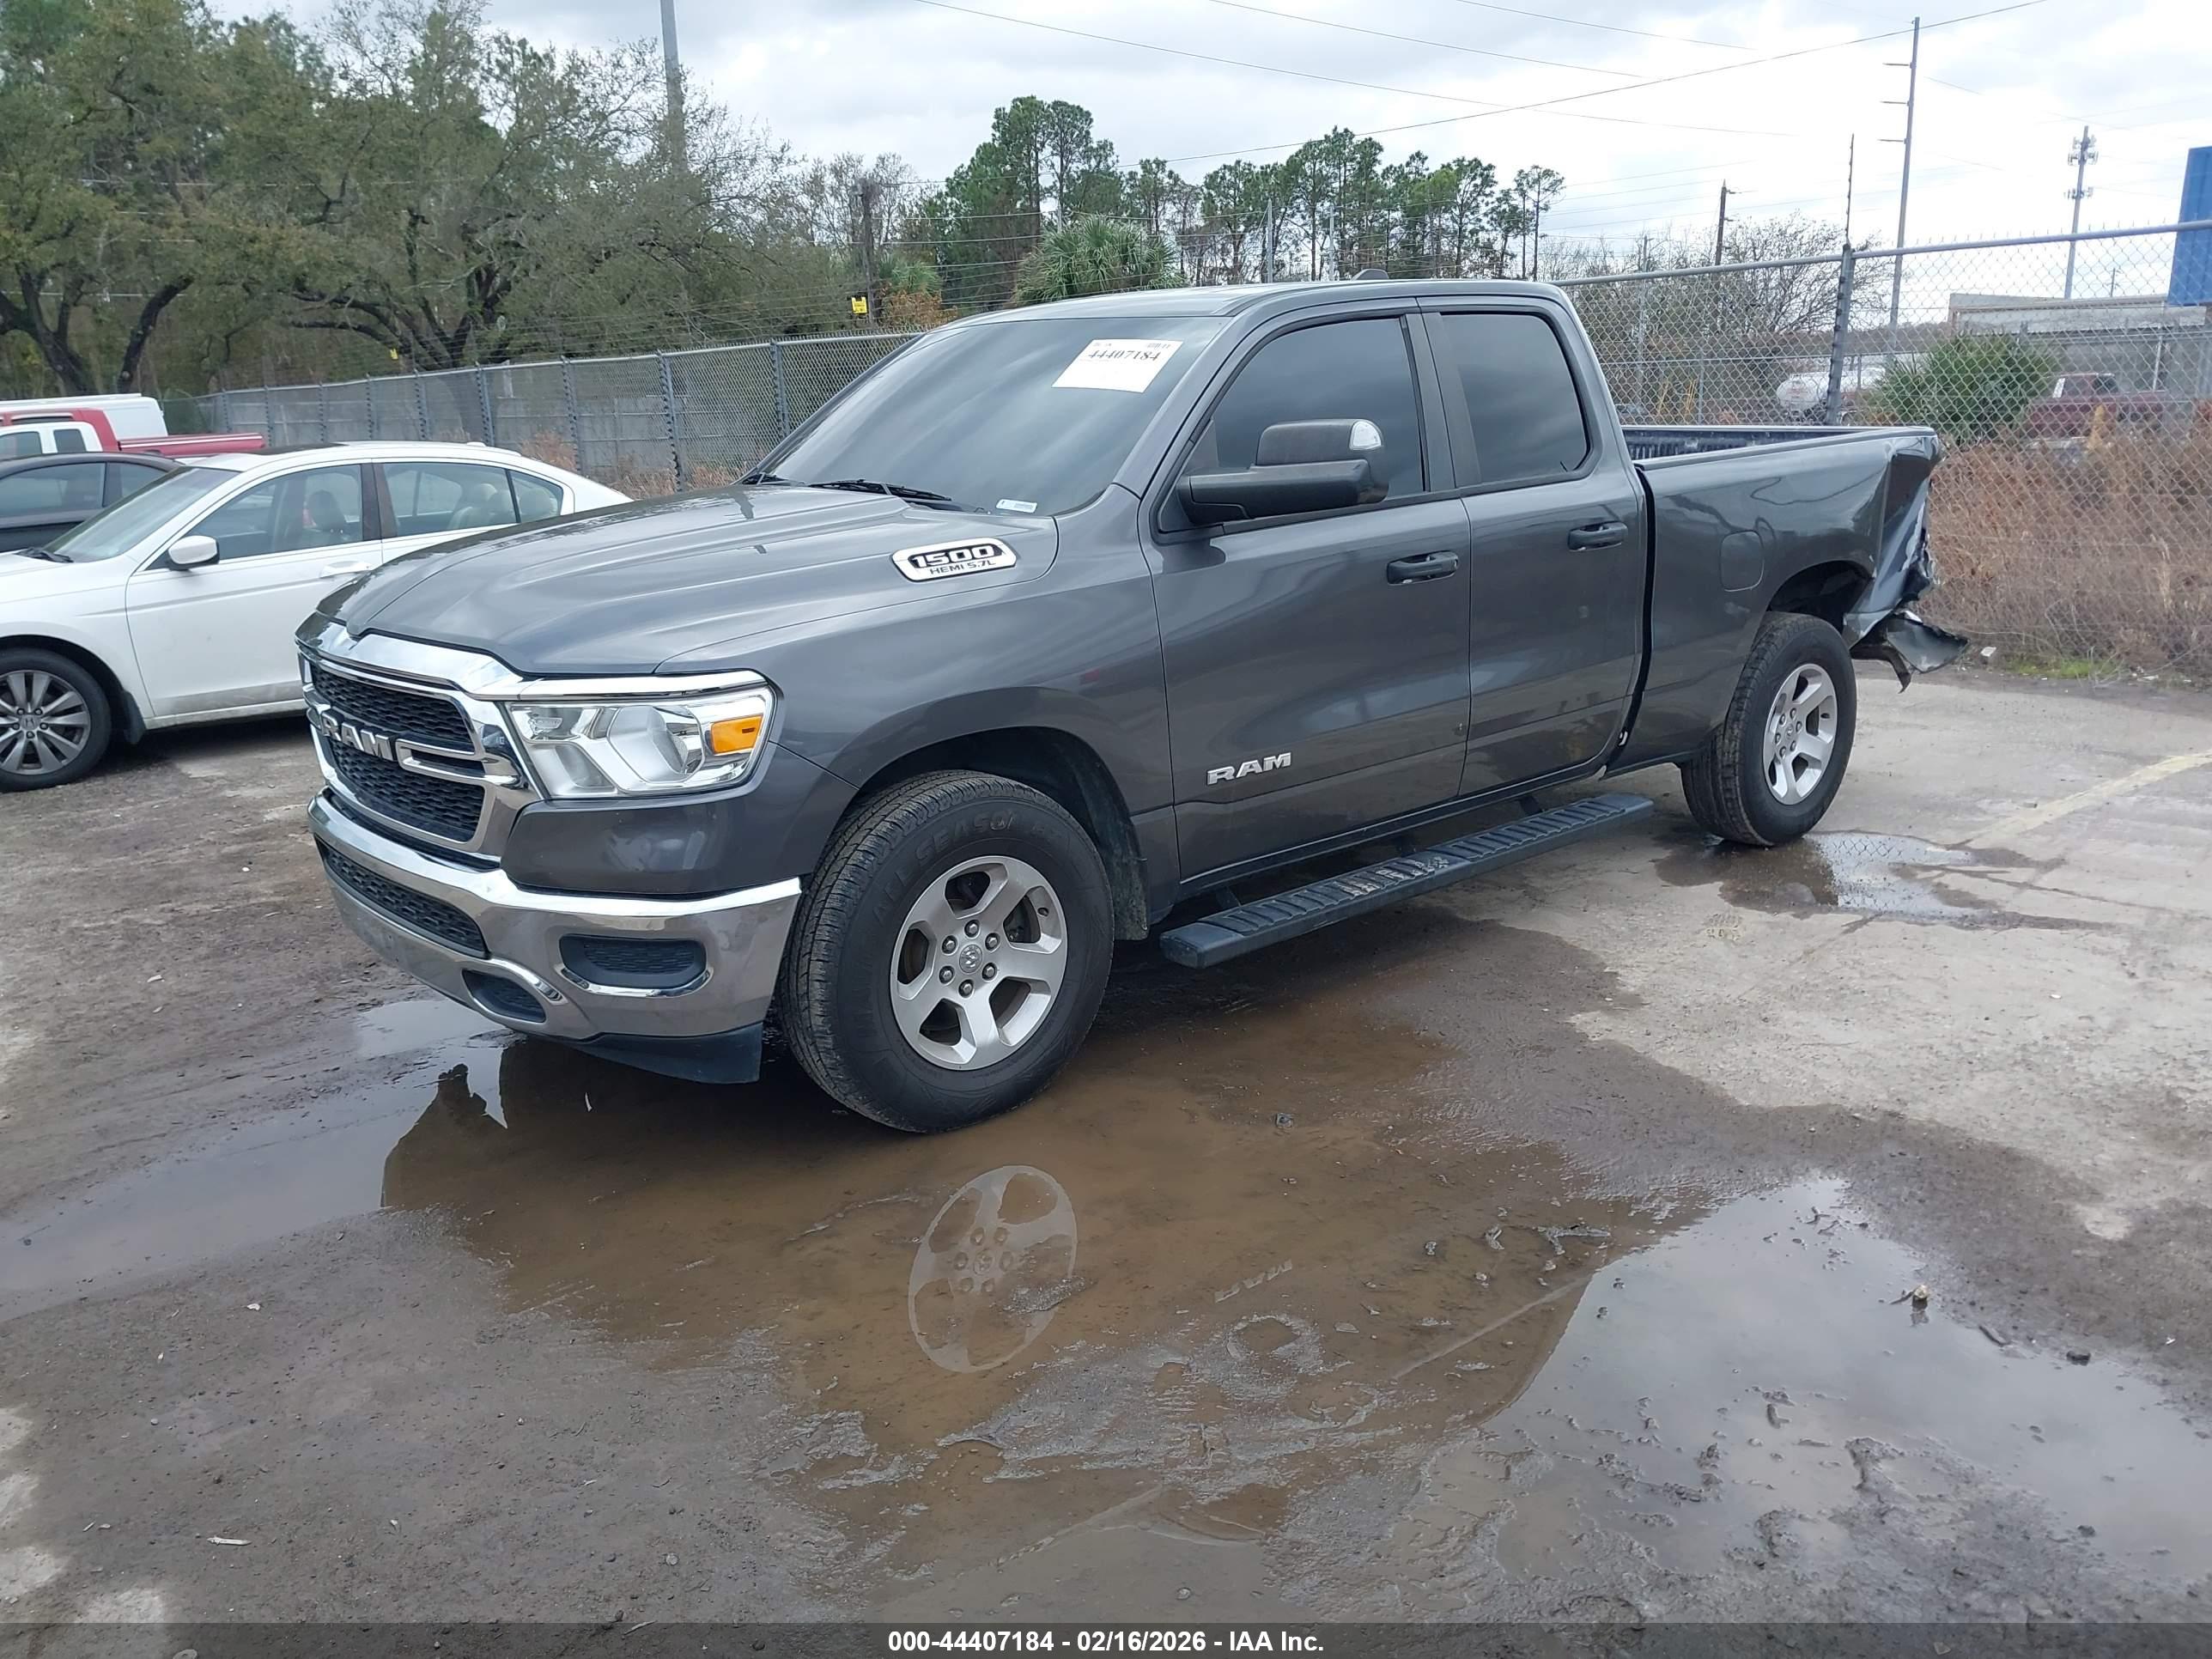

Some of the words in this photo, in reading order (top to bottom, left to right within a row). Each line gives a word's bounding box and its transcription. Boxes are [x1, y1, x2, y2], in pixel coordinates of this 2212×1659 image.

[1088, 349, 1161, 362] 44407184
[912, 545, 994, 568] 1500
[930, 565, 964, 575] HEMI
[967, 559, 996, 569] 5.7L
[321, 710, 394, 761] RAM
[1207, 752, 1291, 785] RAM
